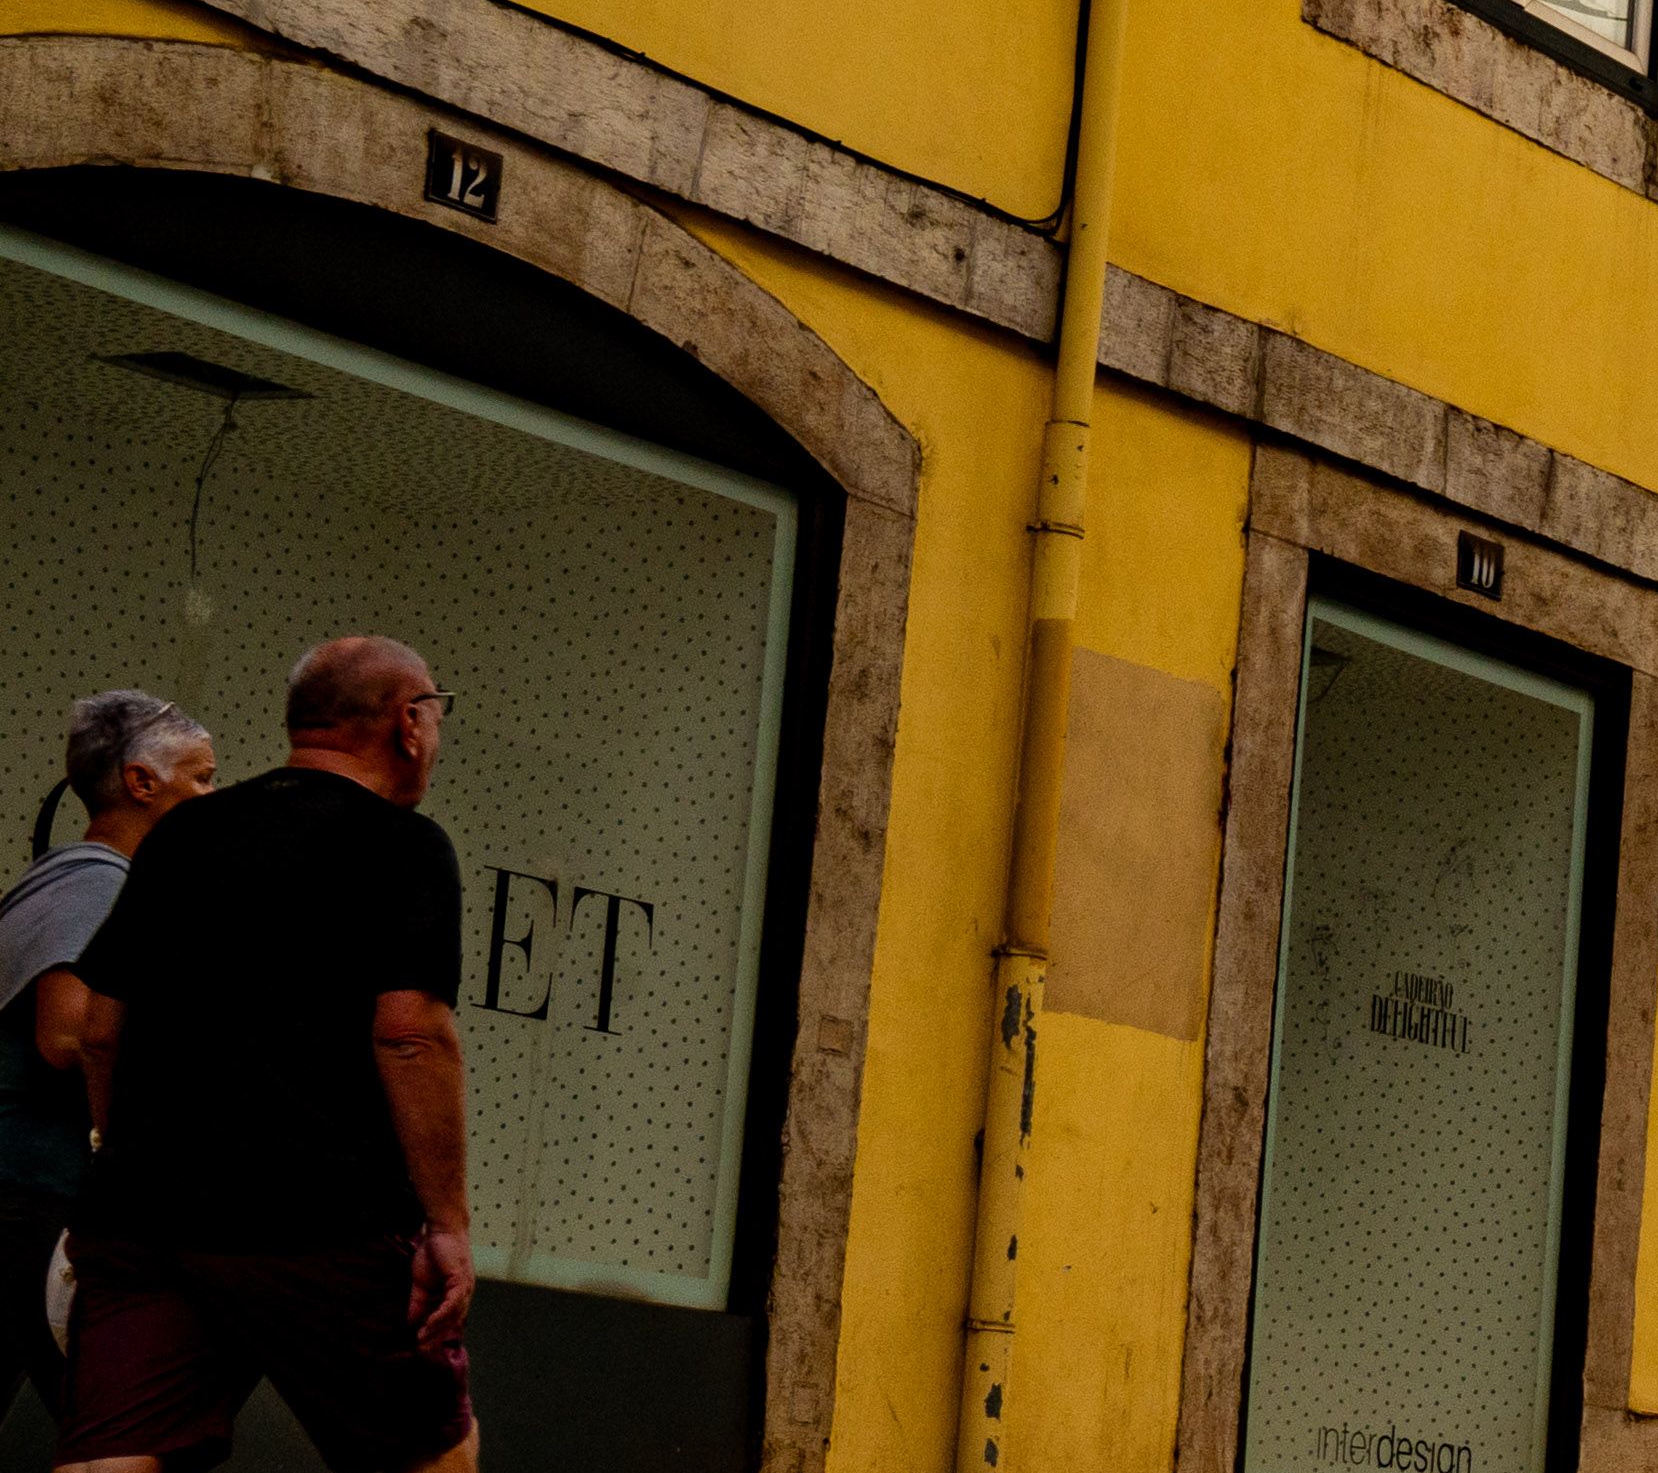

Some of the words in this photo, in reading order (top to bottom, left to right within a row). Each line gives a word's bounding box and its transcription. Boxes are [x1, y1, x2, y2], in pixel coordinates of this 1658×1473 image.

[447, 150, 487, 209] 12
[470, 864, 655, 1036] ET
[1370, 994, 1471, 1054] DELIGHTFUL
